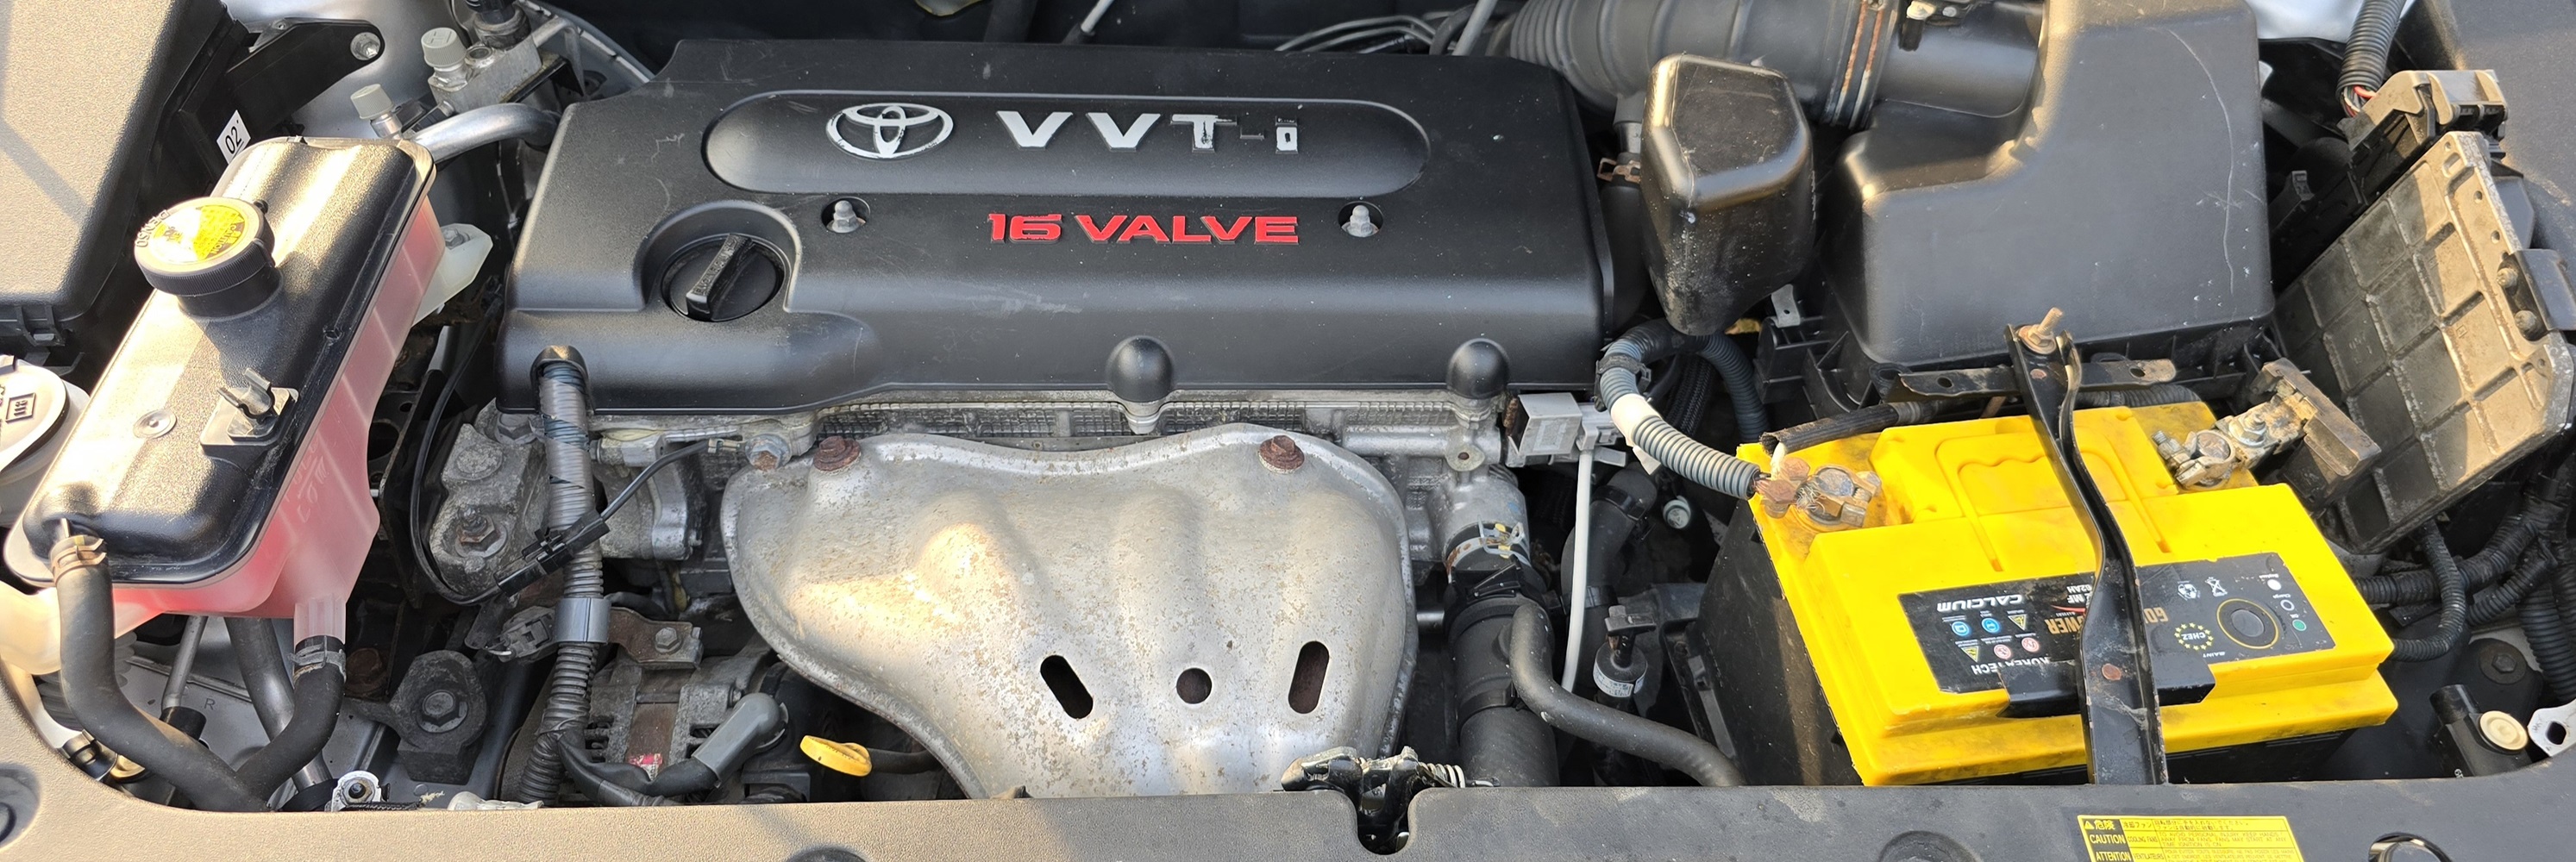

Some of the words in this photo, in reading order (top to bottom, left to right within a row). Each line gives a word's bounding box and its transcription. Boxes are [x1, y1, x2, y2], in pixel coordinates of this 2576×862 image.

[225, 126, 242, 154] 02
[135, 209, 171, 248] DENSO
[988, 213, 1062, 244] 16
[1075, 215, 1300, 245] VALVE
[210, 222, 237, 254] CAUTION
[1937, 594, 2023, 613] CALCIUM
[2066, 594, 2083, 604] MF
[2180, 631, 2206, 640] CHEZ
[204, 698, 216, 710] R
[2089, 834, 2126, 845] CAUTION
[2095, 851, 2132, 862] ATTENTION
